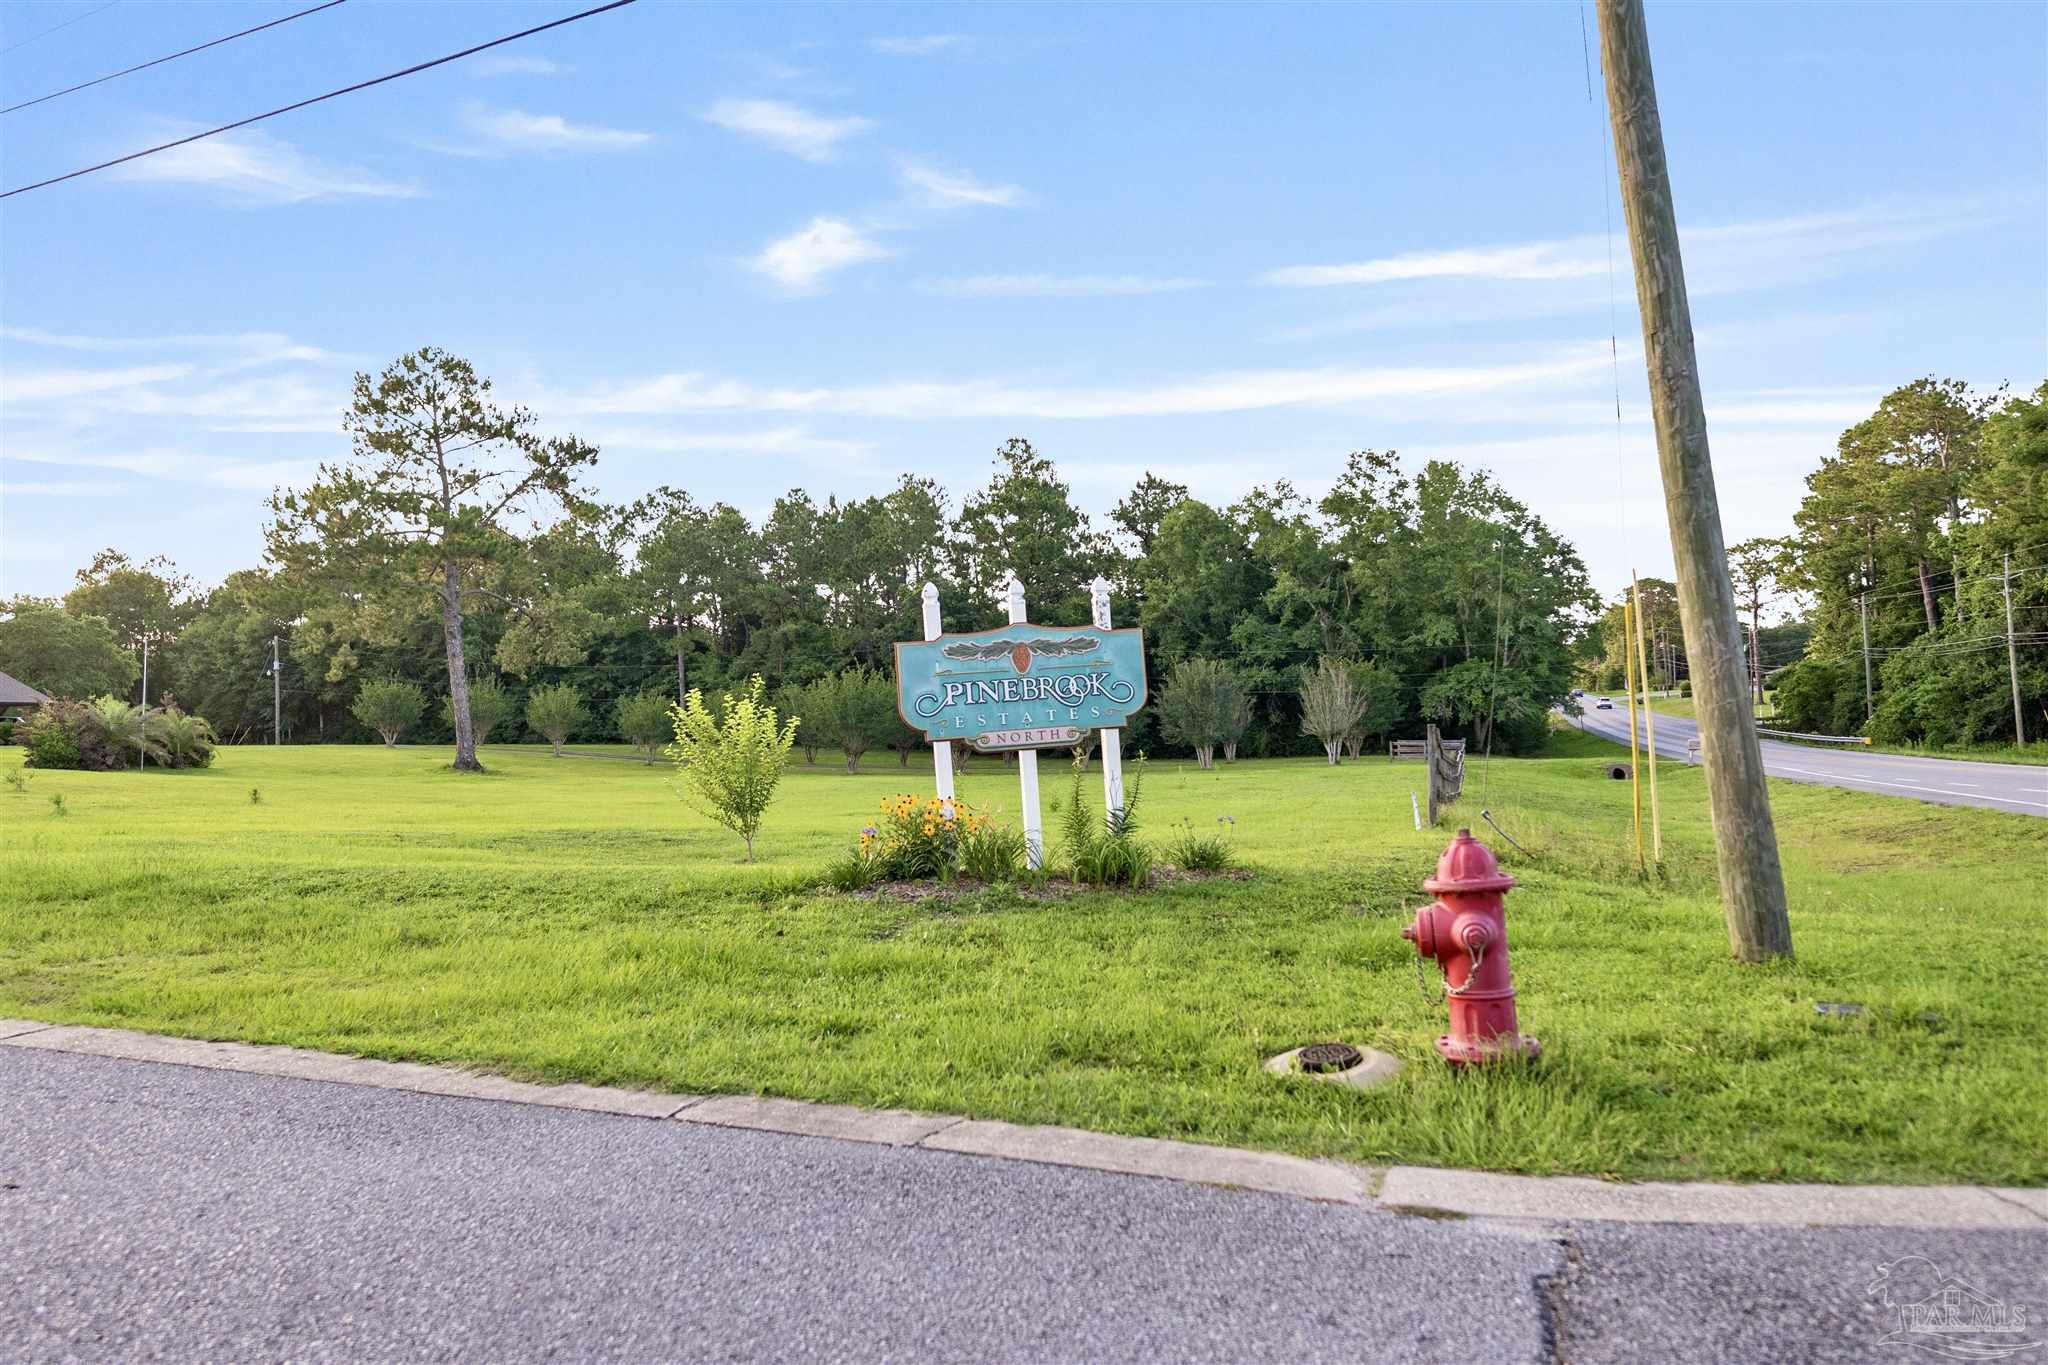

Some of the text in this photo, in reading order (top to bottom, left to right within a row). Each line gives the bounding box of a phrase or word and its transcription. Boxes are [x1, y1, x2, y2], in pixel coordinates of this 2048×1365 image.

[915, 672, 1135, 718] PINEBROOK
[954, 705, 1101, 729] ESTATES
[995, 729, 1061, 745] NORTH
